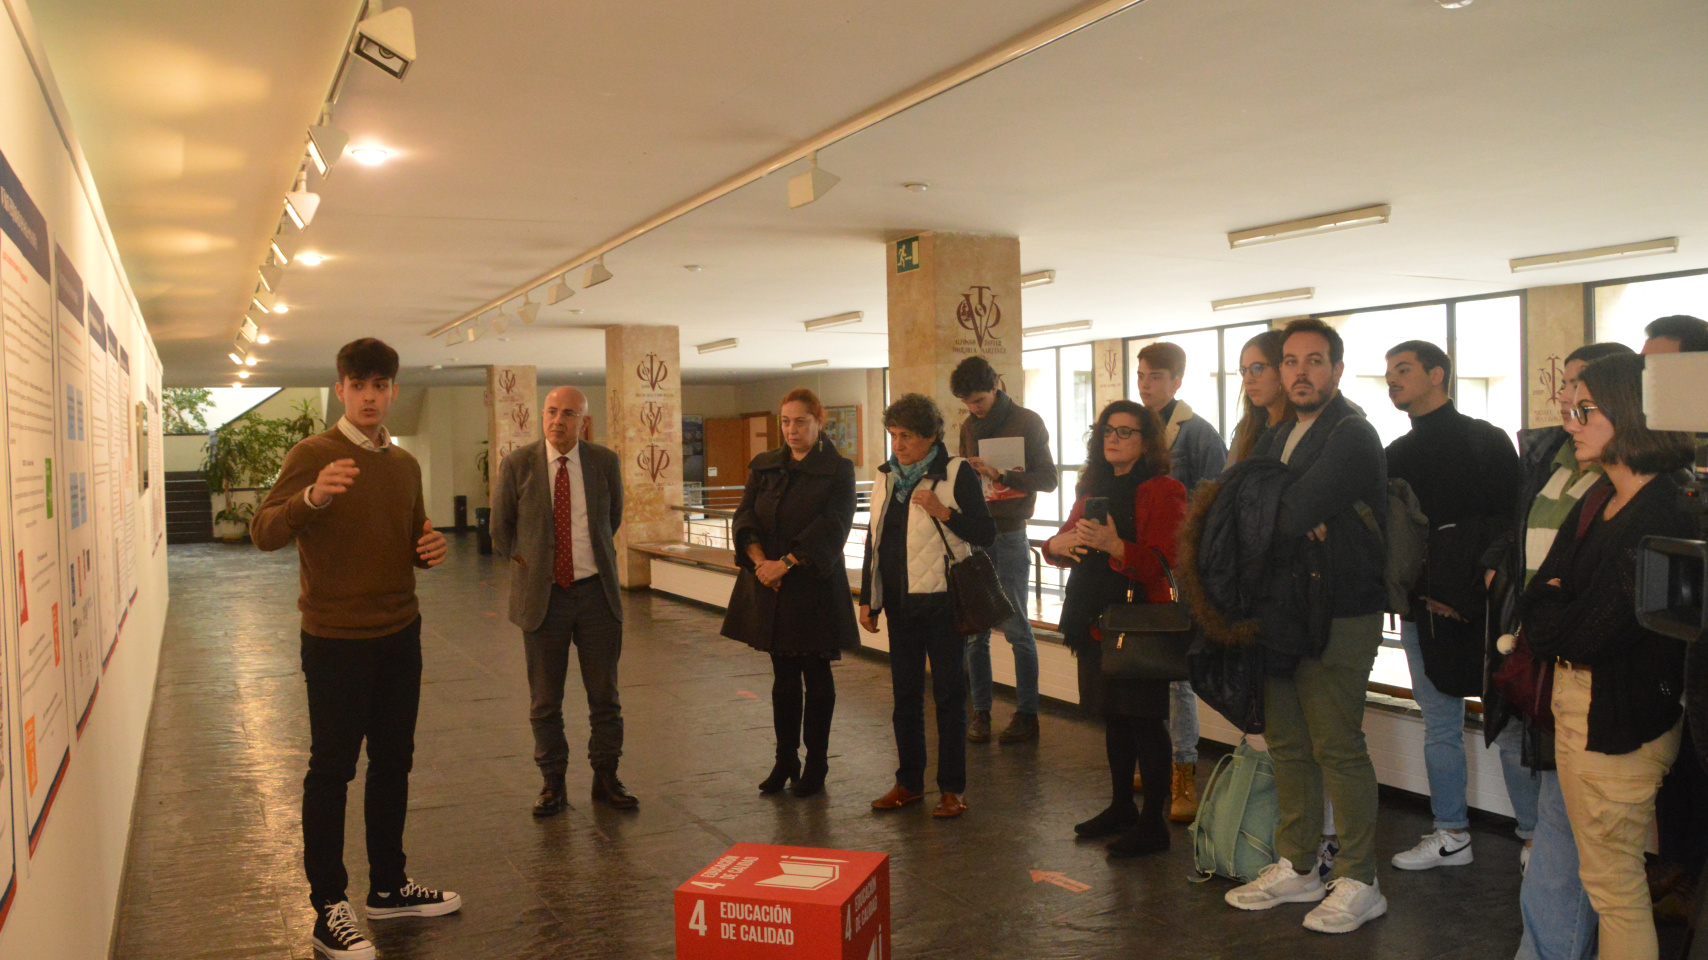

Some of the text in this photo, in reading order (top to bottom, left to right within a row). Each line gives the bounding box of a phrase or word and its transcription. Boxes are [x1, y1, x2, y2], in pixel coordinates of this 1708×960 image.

[691, 881, 726, 889] 4
[689, 900, 792, 936] 4 EDUCACIÓN
[845, 904, 852, 941] 4
[721, 922, 794, 946] DE CALIDAD
